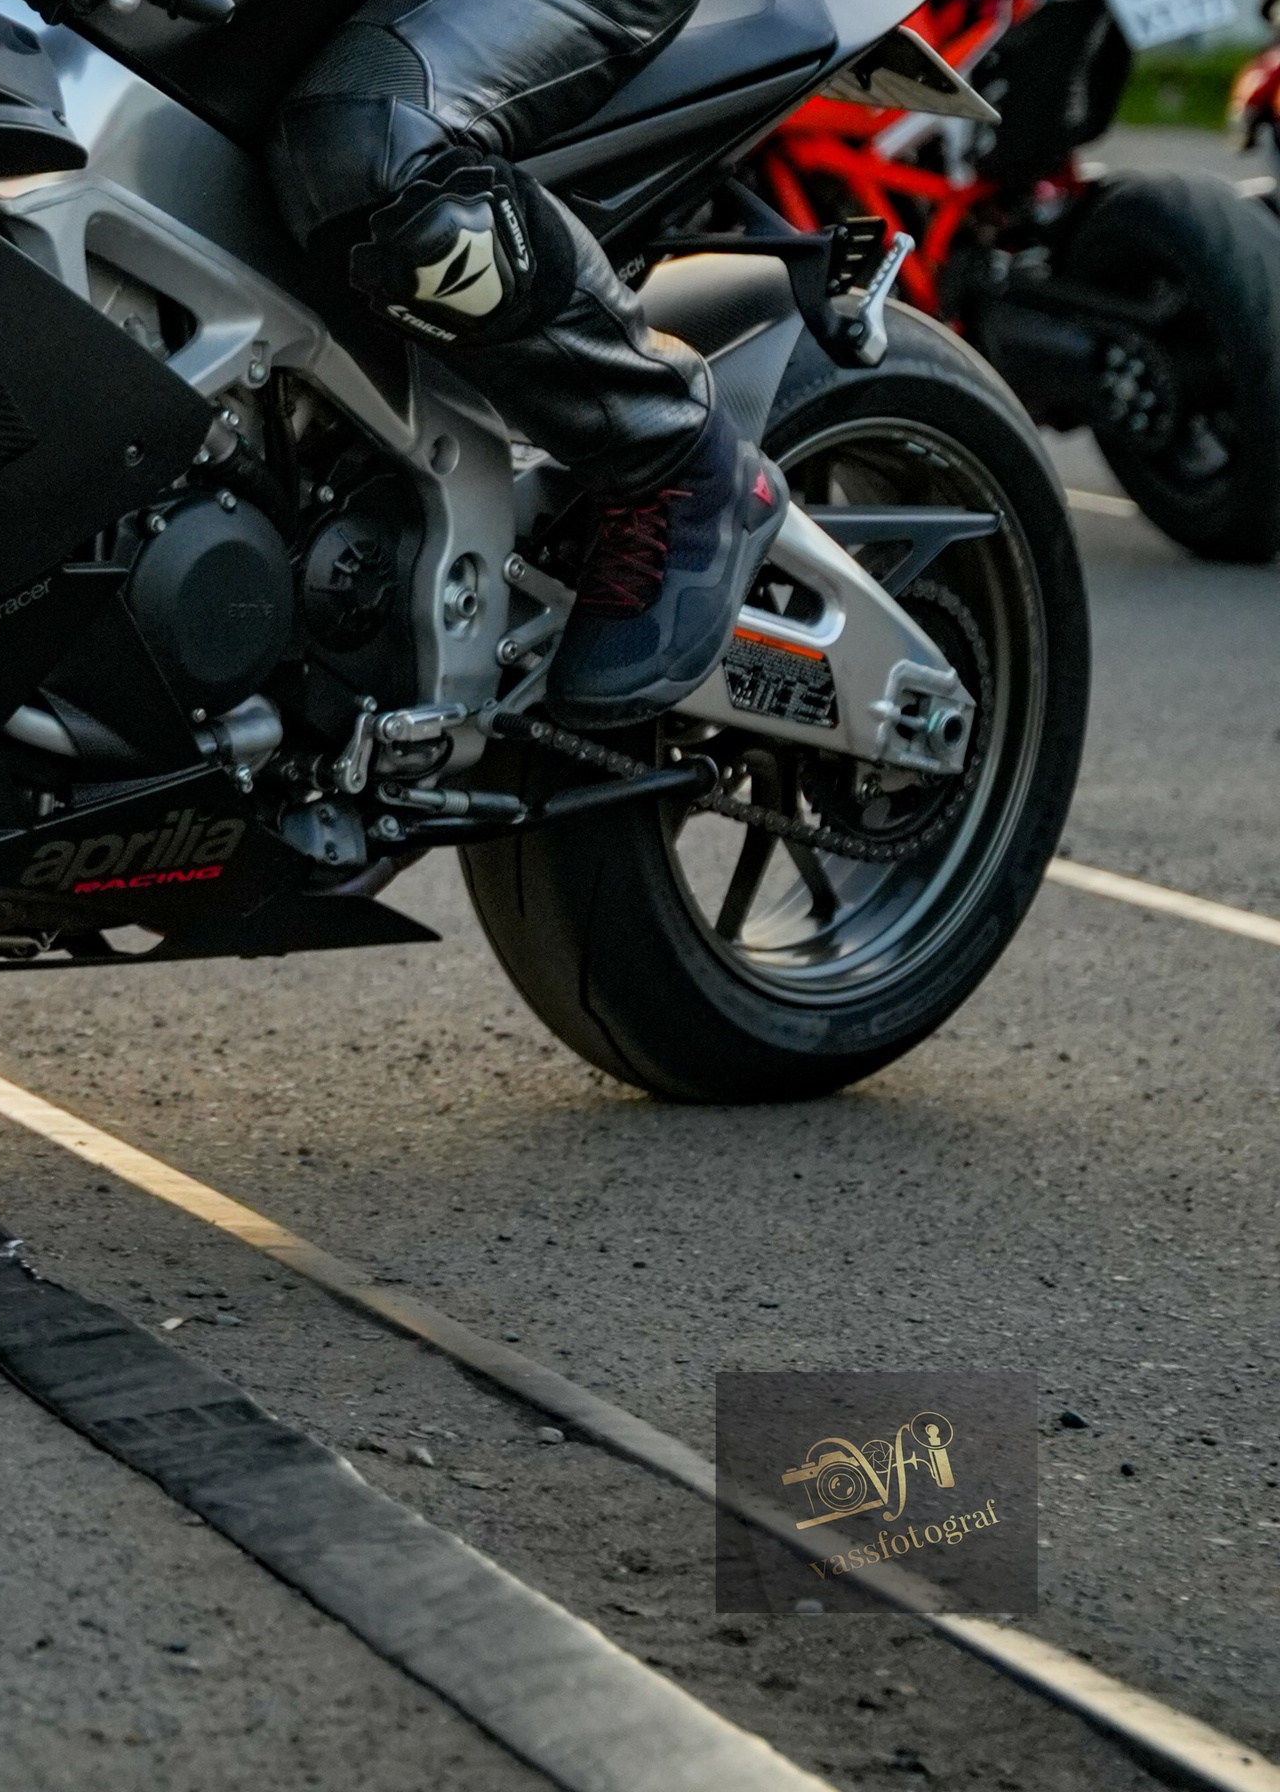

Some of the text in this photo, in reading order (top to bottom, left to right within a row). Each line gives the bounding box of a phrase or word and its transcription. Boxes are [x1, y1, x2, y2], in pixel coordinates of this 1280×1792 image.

[500, 198, 527, 257] TAICHI
[402, 312, 458, 342] TAICHI
[20, 808, 247, 893] aprilia
[74, 864, 225, 895] RACING
